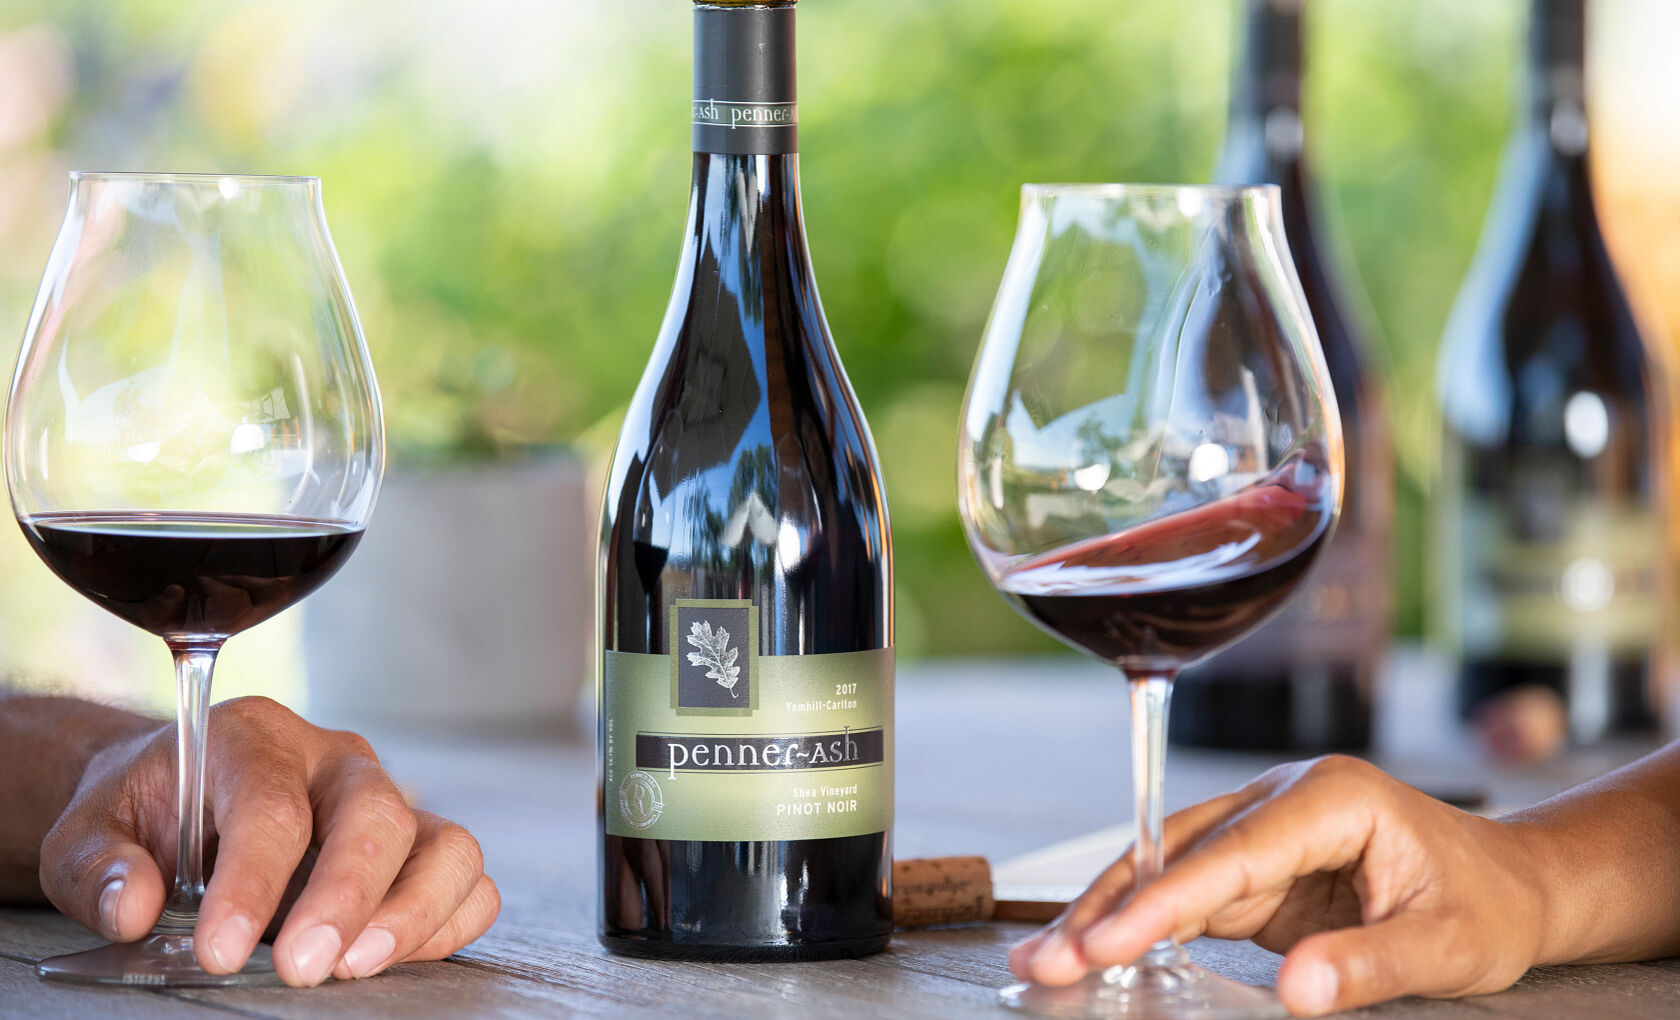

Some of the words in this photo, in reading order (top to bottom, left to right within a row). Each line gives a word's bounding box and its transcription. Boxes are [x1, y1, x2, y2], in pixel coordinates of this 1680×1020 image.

[835, 683, 857, 695] 2017
[785, 699, 857, 713] Yamhill-Carlton
[793, 788, 816, 798] Shea
[821, 784, 858, 797] Vineyard
[777, 802, 821, 816] PINOT
[827, 799, 857, 814] NOIR
